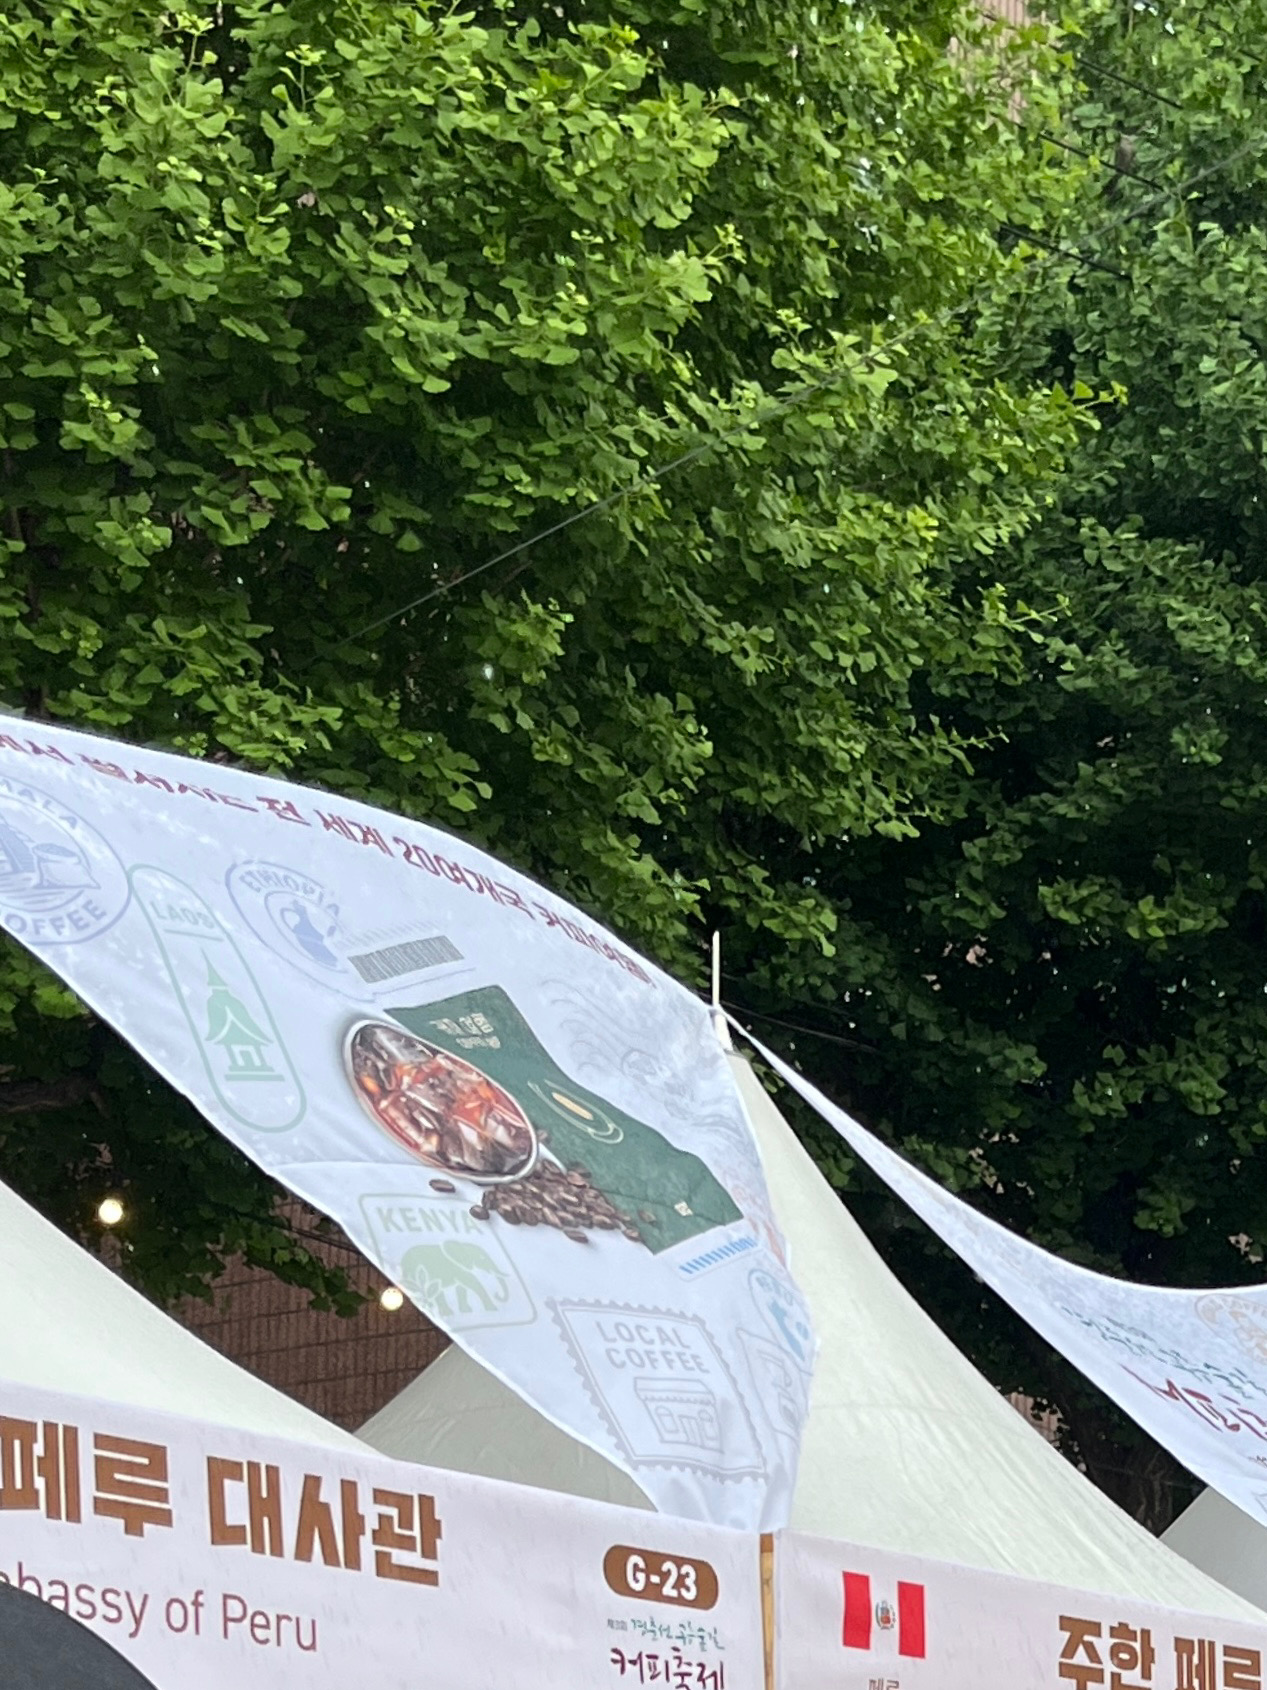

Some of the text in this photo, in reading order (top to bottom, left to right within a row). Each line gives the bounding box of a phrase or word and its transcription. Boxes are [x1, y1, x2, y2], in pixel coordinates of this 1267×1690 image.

[314, 809, 395, 858] 세계
[150, 900, 217, 931] LAOS
[376, 1206, 486, 1236] KENYA
[595, 1320, 691, 1351] LOCAL
[606, 1347, 711, 1375] COFFEE
[0, 1414, 442, 1587] 페루 대사관
[625, 1554, 698, 1602] G-23
[0, 1561, 318, 1652] bassy of Peru
